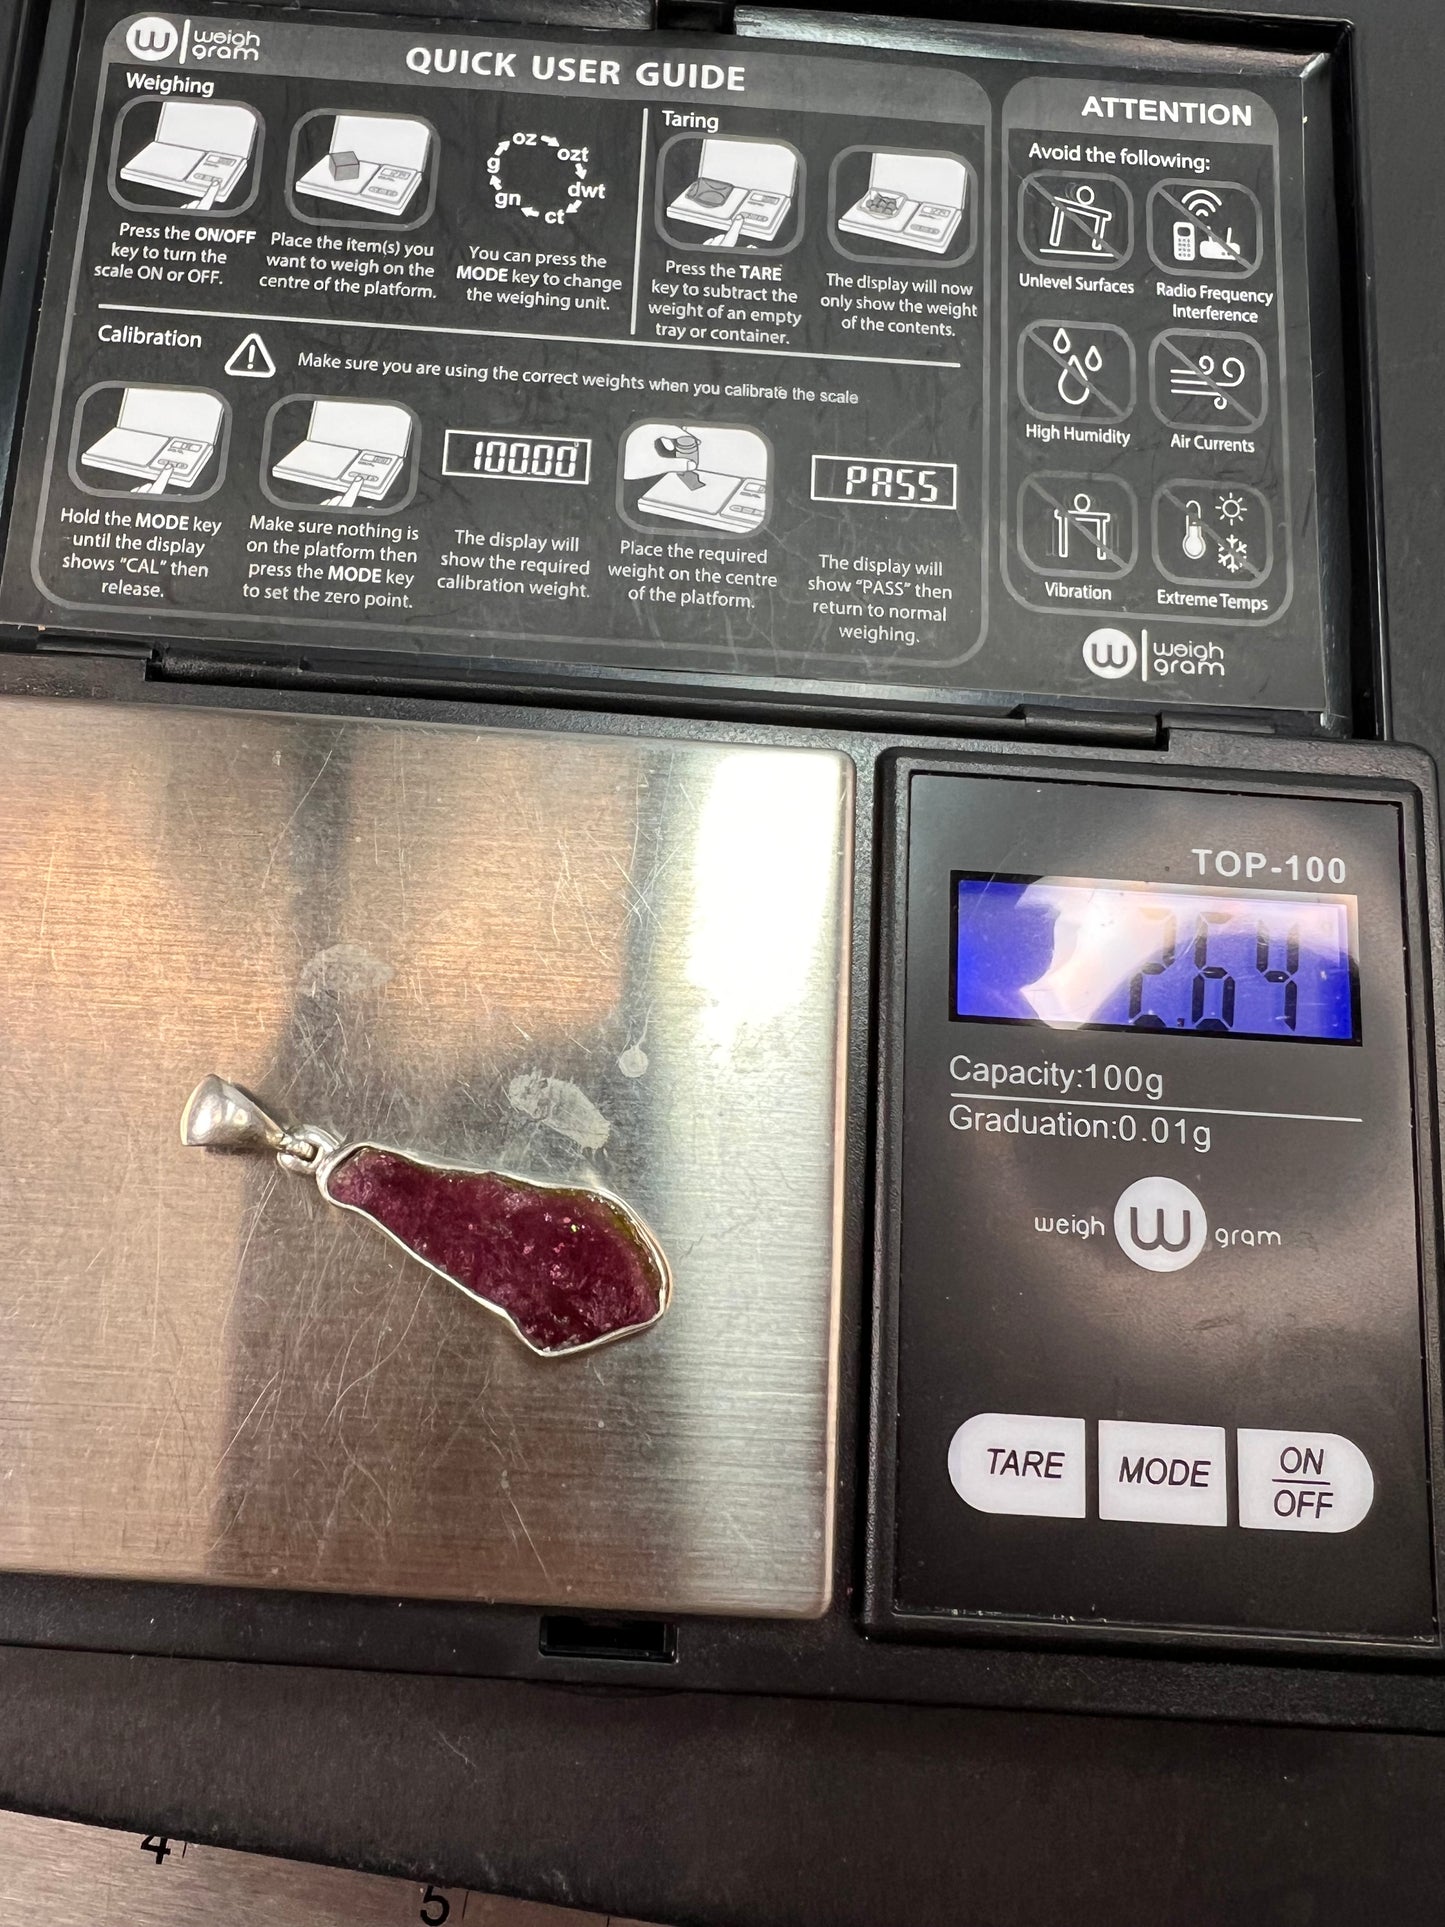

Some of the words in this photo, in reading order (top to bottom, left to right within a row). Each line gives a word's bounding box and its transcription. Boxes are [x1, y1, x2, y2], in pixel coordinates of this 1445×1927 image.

[194, 30, 260, 47] weigh
[192, 44, 260, 62] gram
[406, 47, 517, 77] QUICK
[532, 55, 620, 85] USER
[636, 62, 745, 91] GUIDE
[126, 72, 214, 98] Weighing
[662, 110, 719, 133] Taring
[1081, 96, 1252, 126] ATTENTION
[513, 132, 537, 146] oz
[487, 157, 500, 174] g
[557, 147, 589, 162] ozt
[1029, 143, 1081, 161] Avoid
[1085, 146, 1116, 164] the
[1120, 148, 1210, 173] following:
[495, 192, 521, 209] gn
[568, 181, 606, 199] dwt
[545, 209, 565, 224] ct
[120, 222, 160, 238] Press
[165, 225, 190, 240] the
[195, 227, 256, 244] ON/OFF
[111, 242, 139, 261] key
[143, 246, 159, 259] to
[164, 247, 196, 262] turn
[201, 248, 227, 264] the
[271, 232, 312, 248] Place
[317, 235, 343, 250] the
[347, 237, 400, 256] item(s)
[404, 245, 434, 258] you
[266, 256, 306, 268] want
[310, 256, 327, 270] to
[331, 259, 379, 276] weigh
[383, 264, 404, 275] on
[409, 262, 435, 277] the
[469, 246, 499, 261] You
[503, 251, 531, 263] can
[535, 253, 577, 267] press
[581, 254, 607, 268] the
[94, 264, 133, 278] scale
[137, 265, 163, 280] ON
[167, 271, 185, 282] or
[188, 269, 223, 285] OFF.
[456, 265, 508, 282] MODE
[512, 269, 540, 287] key
[543, 273, 560, 285] to
[564, 273, 622, 293] change
[666, 260, 706, 276] Press
[710, 263, 736, 278] the
[739, 265, 782, 281] TARE
[259, 276, 310, 289] centre
[314, 277, 332, 291] of
[334, 278, 360, 293] the
[364, 280, 436, 298] platform.
[652, 279, 679, 297] key
[682, 283, 699, 296] to
[703, 284, 767, 301] subtract
[772, 288, 798, 303] the
[826, 273, 853, 288] The
[857, 275, 908, 294] display
[912, 279, 937, 293] will
[941, 284, 973, 295] now
[1019, 273, 1072, 289] Unlevel
[1075, 276, 1134, 294] Surfaces
[1156, 282, 1197, 298] Radio
[1200, 285, 1273, 306] Frequency
[466, 287, 493, 302] the
[497, 291, 571, 311] weighing
[575, 296, 610, 310] unit.
[648, 303, 703, 319] weight
[707, 304, 725, 319] of
[727, 309, 746, 320] an
[750, 311, 802, 327] empty
[1173, 304, 1258, 323] Interference
[98, 324, 202, 348] Calibration
[656, 323, 686, 340] tray
[690, 328, 707, 338] or
[710, 328, 790, 344] container.
[298, 352, 341, 368] Make
[345, 359, 378, 371] sure
[382, 361, 412, 375] you
[416, 364, 441, 375] are
[445, 364, 488, 382] using
[493, 365, 519, 381] the
[522, 371, 578, 385] correct
[582, 374, 645, 391] weights
[649, 378, 689, 392] when
[693, 383, 720, 397] you
[725, 383, 788, 399] calibrate
[792, 387, 815, 401] the
[820, 390, 859, 404] scale
[1026, 424, 1060, 442] High
[1064, 426, 1131, 447] Humidity
[1171, 433, 1191, 448] Air
[1194, 435, 1255, 453] Currents
[846, 464, 939, 502] PASS
[61, 508, 100, 524] Hold
[105, 510, 131, 527] the
[135, 512, 189, 530] MODE
[193, 516, 222, 536] key
[250, 515, 294, 532] Make
[298, 522, 333, 534] sure
[337, 522, 402, 543] nothing
[407, 526, 419, 540] is
[73, 533, 111, 548] until
[116, 533, 142, 550] the
[146, 536, 205, 558] display
[247, 541, 268, 553] on
[273, 538, 300, 555] the
[304, 541, 375, 560] platform
[380, 546, 417, 563] then
[62, 552, 115, 571] shows
[171, 560, 208, 577] then
[249, 564, 291, 578] press
[297, 563, 323, 579] the
[328, 565, 382, 583] MODE
[386, 569, 415, 589] key
[818, 554, 849, 570] The
[853, 556, 911, 577] display
[915, 561, 942, 576] will
[102, 579, 164, 597] release.
[808, 576, 852, 592] show
[915, 583, 952, 599] then
[1045, 581, 1112, 600] Vibration
[813, 601, 862, 616] return
[867, 604, 884, 617] to
[889, 606, 946, 621] normal
[1157, 589, 1218, 608] Extreme
[1219, 593, 1268, 613] Temps
[839, 625, 920, 646] weighing.
[1153, 642, 1224, 659] weigh
[1153, 658, 1225, 676] gram
[1191, 848, 1346, 883] TOP-100
[1035, 1216, 1105, 1240] weigh
[1215, 1228, 1281, 1248] gram
[987, 1448, 1065, 1479] TARE
[1119, 1456, 1211, 1487] MODE
[1280, 1446, 1324, 1475] ON
[1274, 1489, 1334, 1519] OFF
[140, 1836, 171, 1864] 4
[420, 1885, 450, 1927] 5
